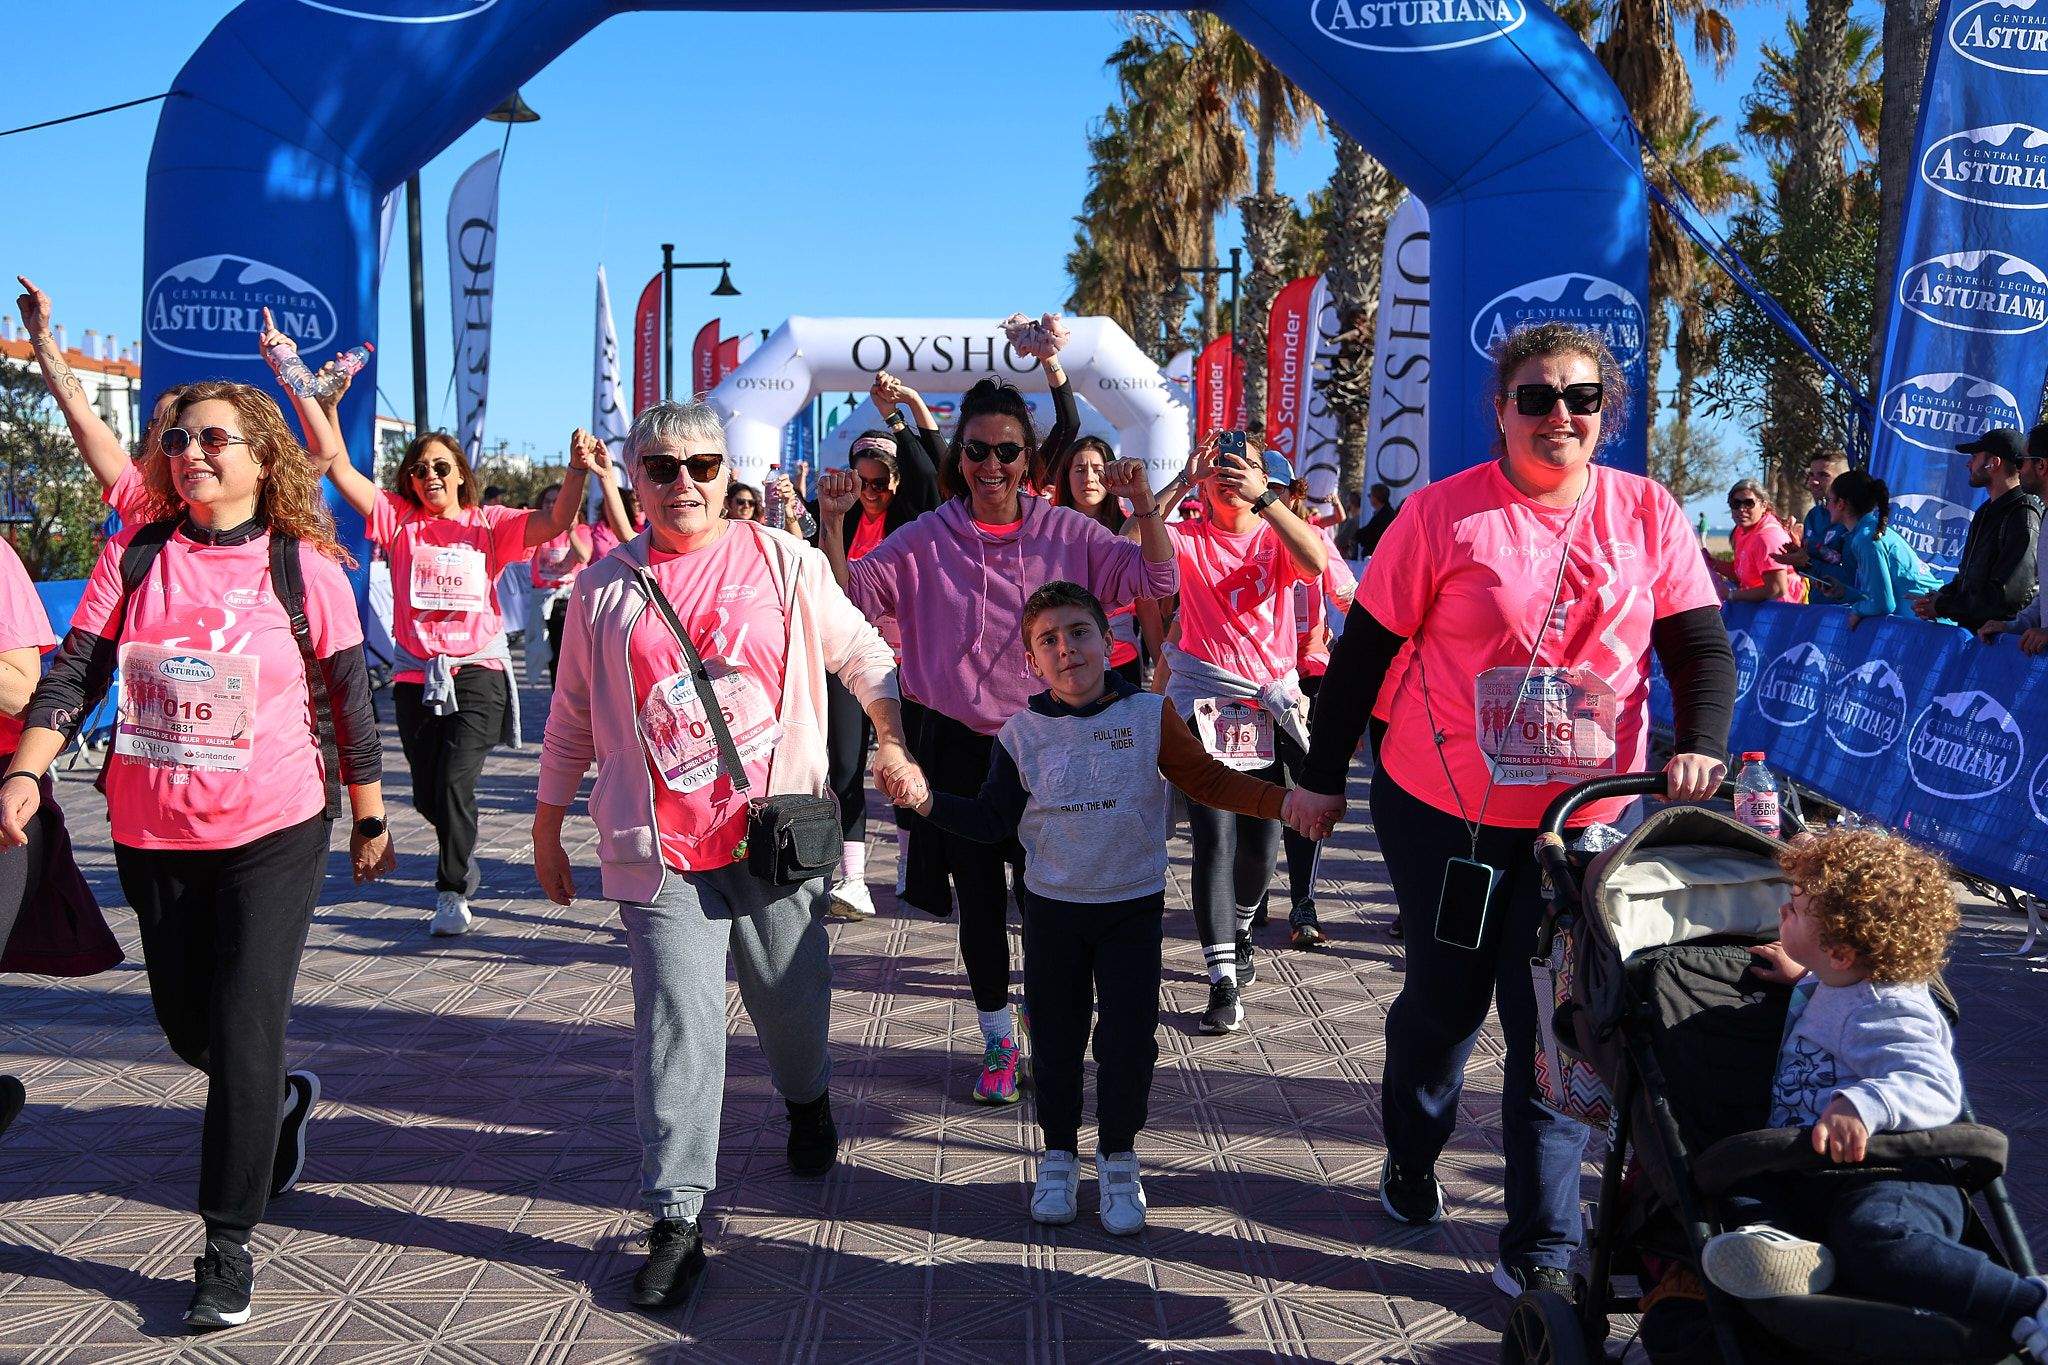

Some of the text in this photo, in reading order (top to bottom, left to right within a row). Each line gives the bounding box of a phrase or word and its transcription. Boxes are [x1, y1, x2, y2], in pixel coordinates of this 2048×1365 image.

[1328, 0, 1516, 30] ASTURIANA
[1993, 14, 2047, 25] CENTRAL
[1960, 14, 2048, 52] ASTUR
[1963, 149, 2020, 162] CENTRAL
[1930, 148, 2048, 191] ASTURIA
[1937, 273, 2046, 296] CENTRAL LECHERA
[172, 289, 317, 309] CENTRAL LECHERA
[1908, 272, 2045, 321] ASTURIANA
[1515, 308, 1581, 319] CENTRAL
[458, 218, 495, 450] YSHO
[1278, 309, 1301, 424] Santander
[1376, 231, 1430, 488] OYSHO
[736, 377, 794, 391] OYSHO
[1099, 378, 1157, 390] OYSHO
[1911, 393, 1963, 409] CENTRAL
[732, 455, 763, 467] SHO
[1145, 458, 1184, 470] YSHO
[436, 575, 463, 587] 016
[162, 663, 212, 678] ASTURIANA
[163, 698, 213, 721] 016
[170, 723, 194, 733] 4831
[689, 706, 734, 739] 06
[135, 728, 161, 740] CARRERA
[161, 732, 169, 740] DE
[169, 733, 177, 741] LA
[178, 735, 200, 744] MUJER
[1093, 727, 1133, 741] FULL TIME
[1522, 721, 1573, 741] 016
[132, 739, 237, 762] OYSHO Santander
[1110, 738, 1135, 750] RIDER
[1911, 721, 2007, 785] ATURIANA
[682, 764, 719, 786] OYSHO
[1503, 769, 1534, 779] YSHO
[1086, 801, 1100, 811] THE
[1101, 799, 1117, 810] WAY
[1750, 802, 1776, 810] ZERO
